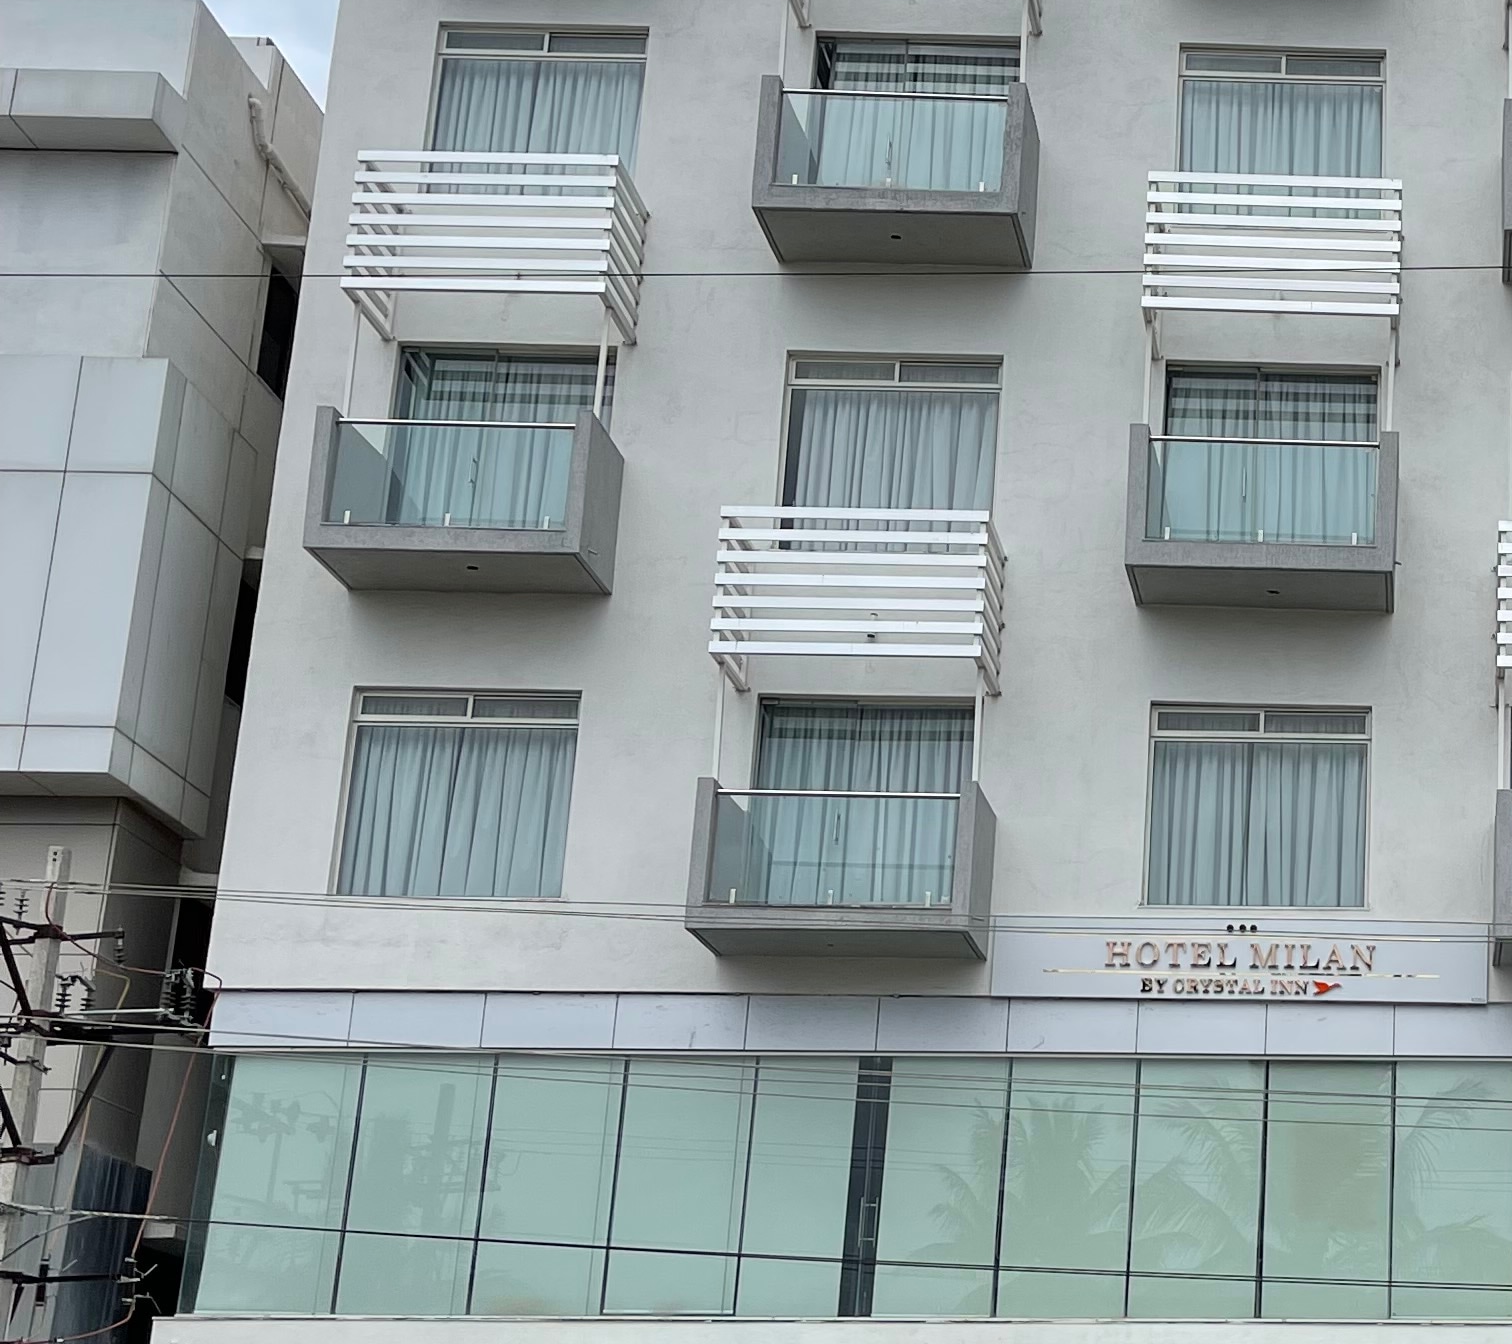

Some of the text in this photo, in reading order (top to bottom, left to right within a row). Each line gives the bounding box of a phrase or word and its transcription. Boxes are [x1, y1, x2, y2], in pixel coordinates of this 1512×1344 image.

[1104, 941, 1376, 971] HOTEL MILAN
[1140, 977, 1310, 995] BY CRYSTAL INN
